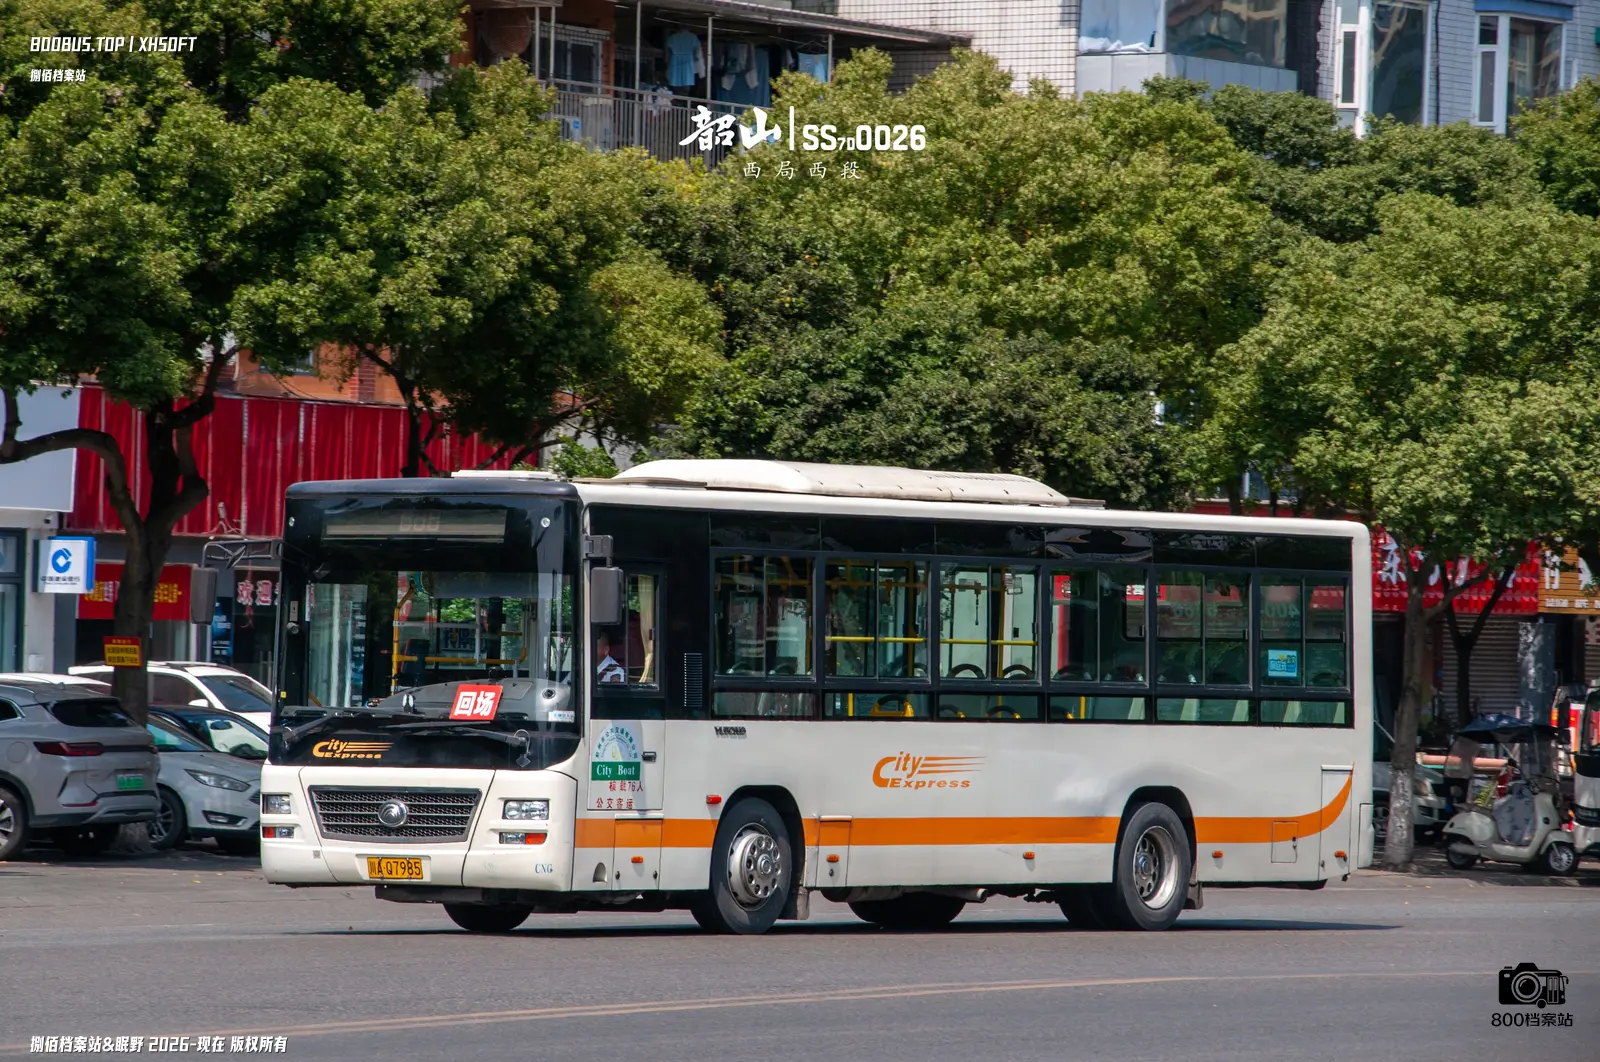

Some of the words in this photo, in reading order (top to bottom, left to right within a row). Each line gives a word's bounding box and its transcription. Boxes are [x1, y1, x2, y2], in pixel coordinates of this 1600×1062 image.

[453, 690, 496, 717] 回场
[312, 738, 348, 758] City
[596, 764, 613, 778] City
[618, 764, 635, 776] Boat
[872, 751, 922, 788] City
[889, 777, 971, 790] Express
[596, 797, 634, 809] 公交客运
[534, 863, 553, 874] CNG
